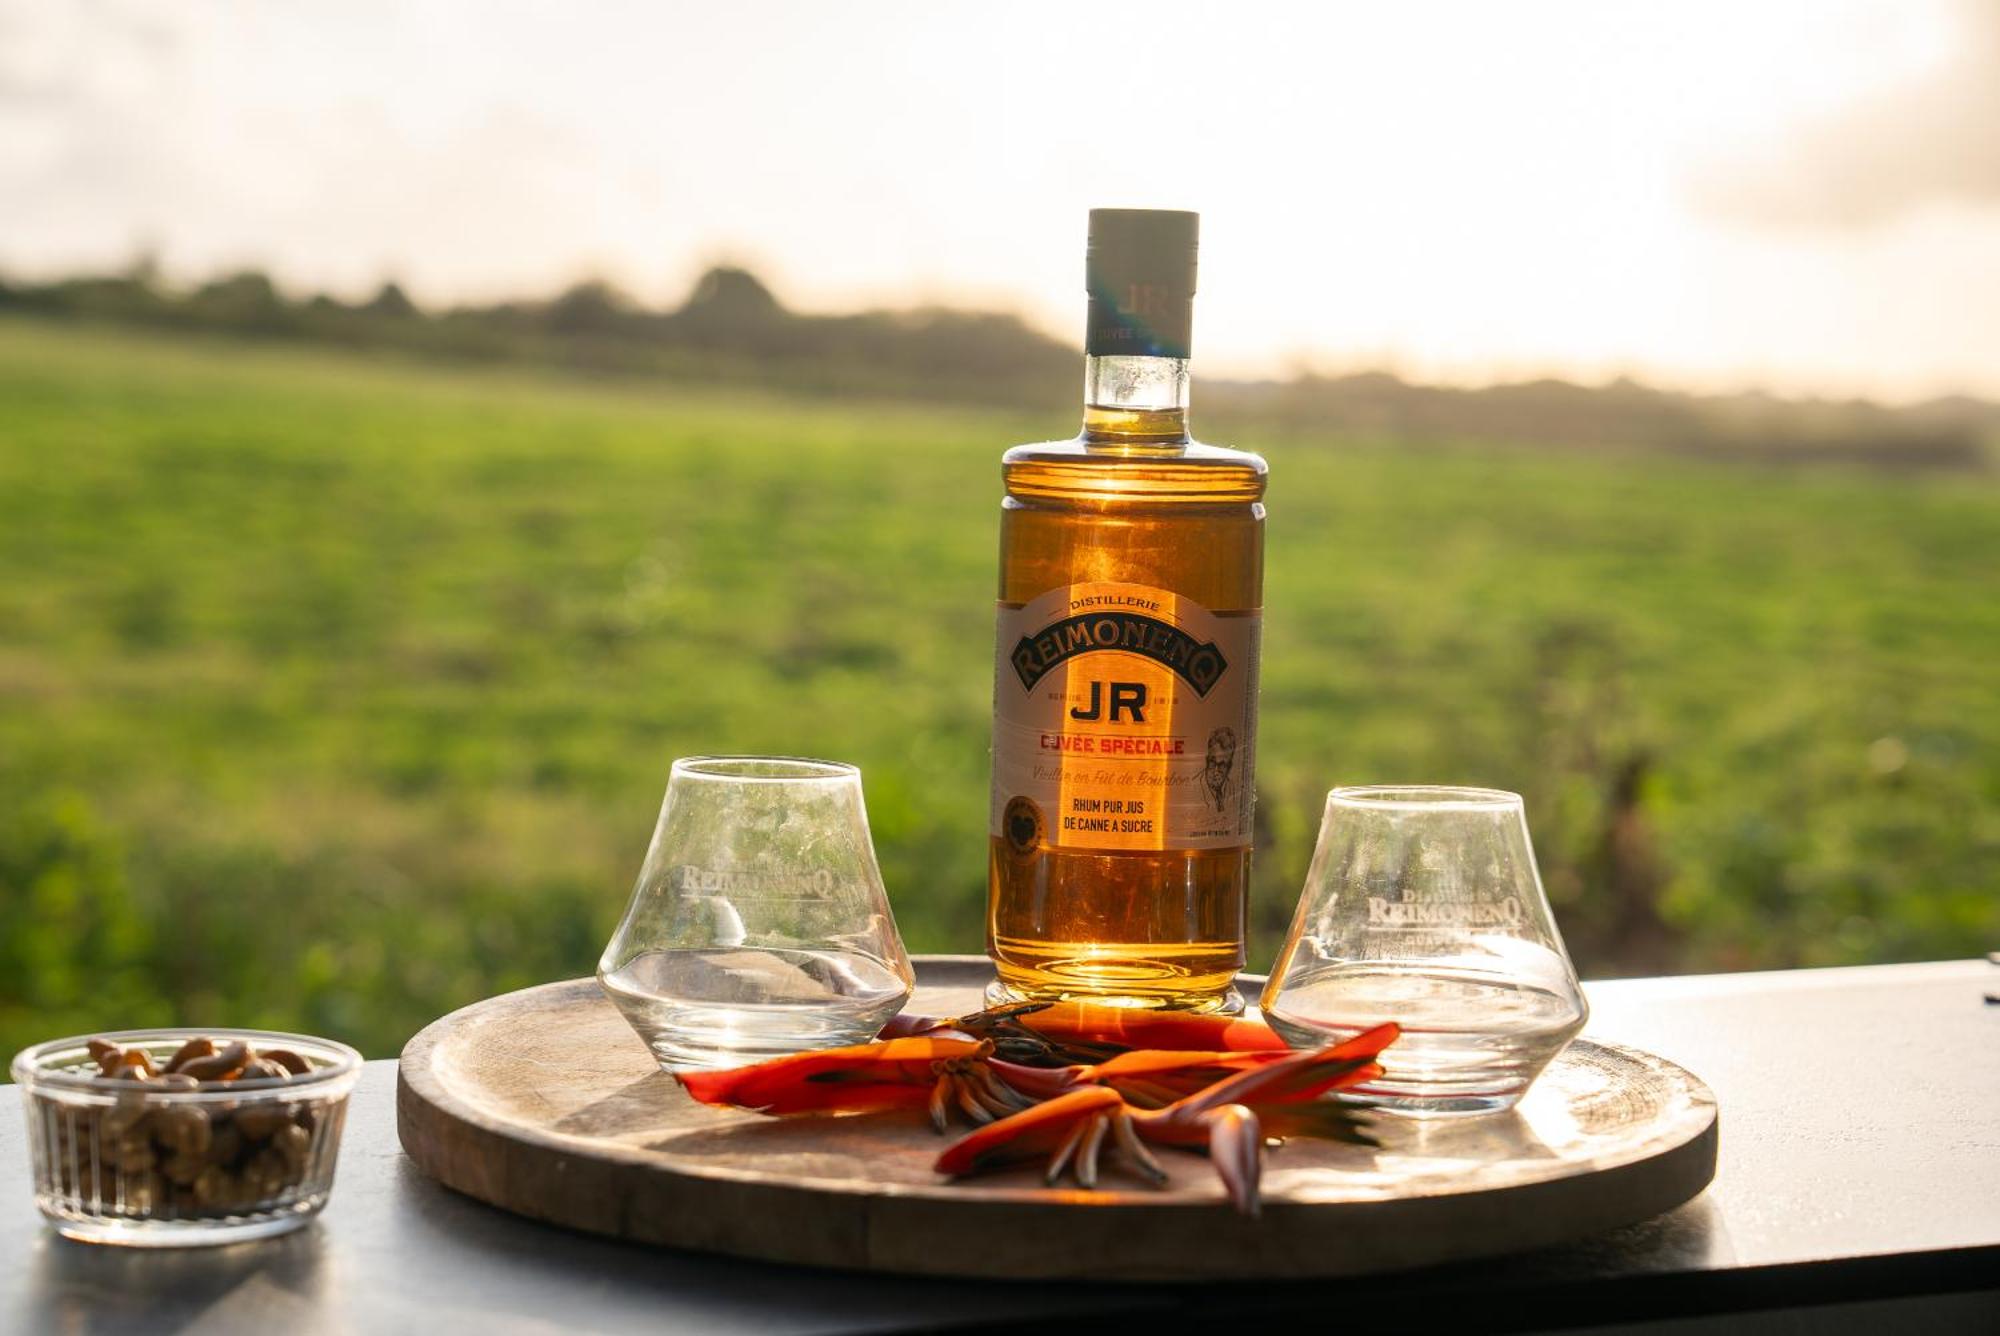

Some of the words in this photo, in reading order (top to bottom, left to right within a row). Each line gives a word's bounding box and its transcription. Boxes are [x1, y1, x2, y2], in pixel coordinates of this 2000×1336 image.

[1070, 595, 1161, 613] DISTILLERIE
[1013, 617, 1222, 684] REIMONENQ
[1070, 680, 1148, 722] JR
[1040, 733, 1095, 753] CUVÉE
[1100, 735, 1185, 756] SPÉCIALE
[1072, 798, 1101, 813] RHUM
[1103, 800, 1124, 814] PUR
[1125, 800, 1145, 814] JUS
[1064, 816, 1077, 831] DE
[1078, 817, 1110, 833] CANNE
[1120, 819, 1153, 834] SUCRE
